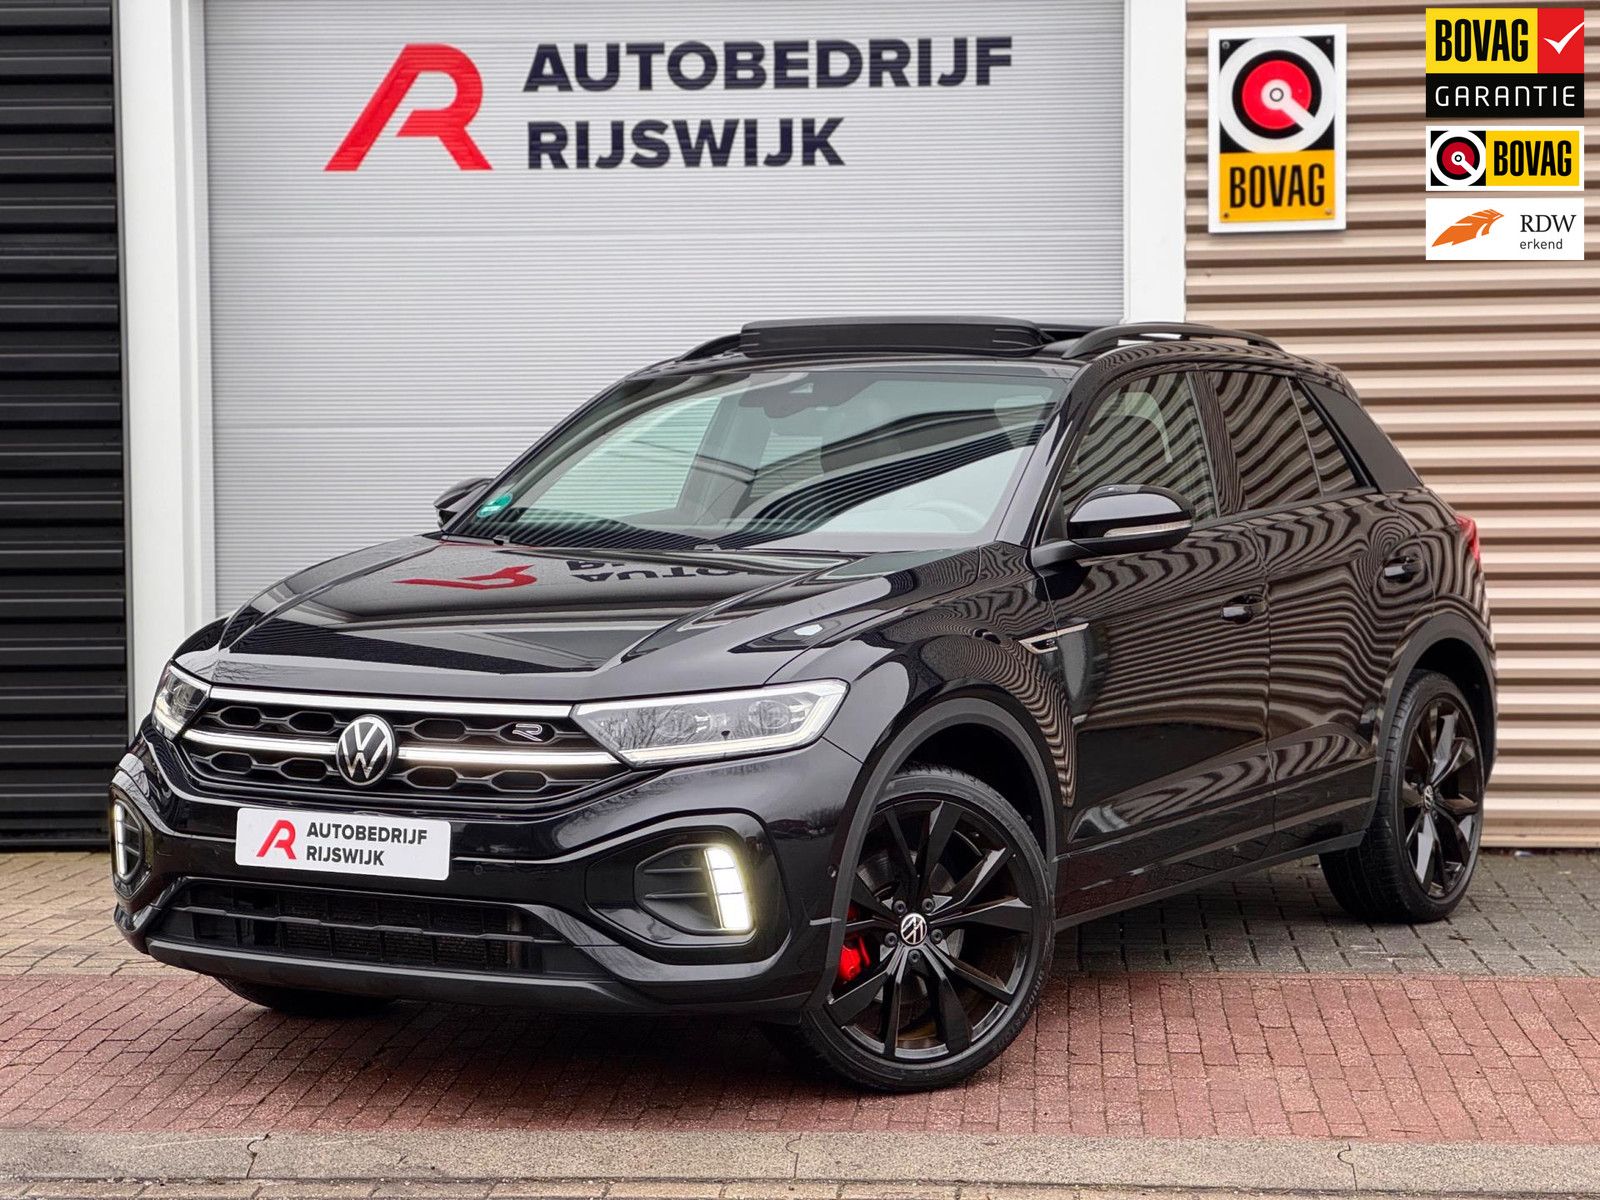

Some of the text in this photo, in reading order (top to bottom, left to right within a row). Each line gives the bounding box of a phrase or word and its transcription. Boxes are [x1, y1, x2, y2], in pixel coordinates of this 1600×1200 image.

[523, 36, 1012, 92] AUTOBEDRIJF
[528, 117, 845, 170] RIJSWIJK
[1229, 163, 1325, 208] BOVAG
[306, 822, 428, 845] AUTOBEDRIJF
[306, 845, 385, 866] RIJSWIJK
